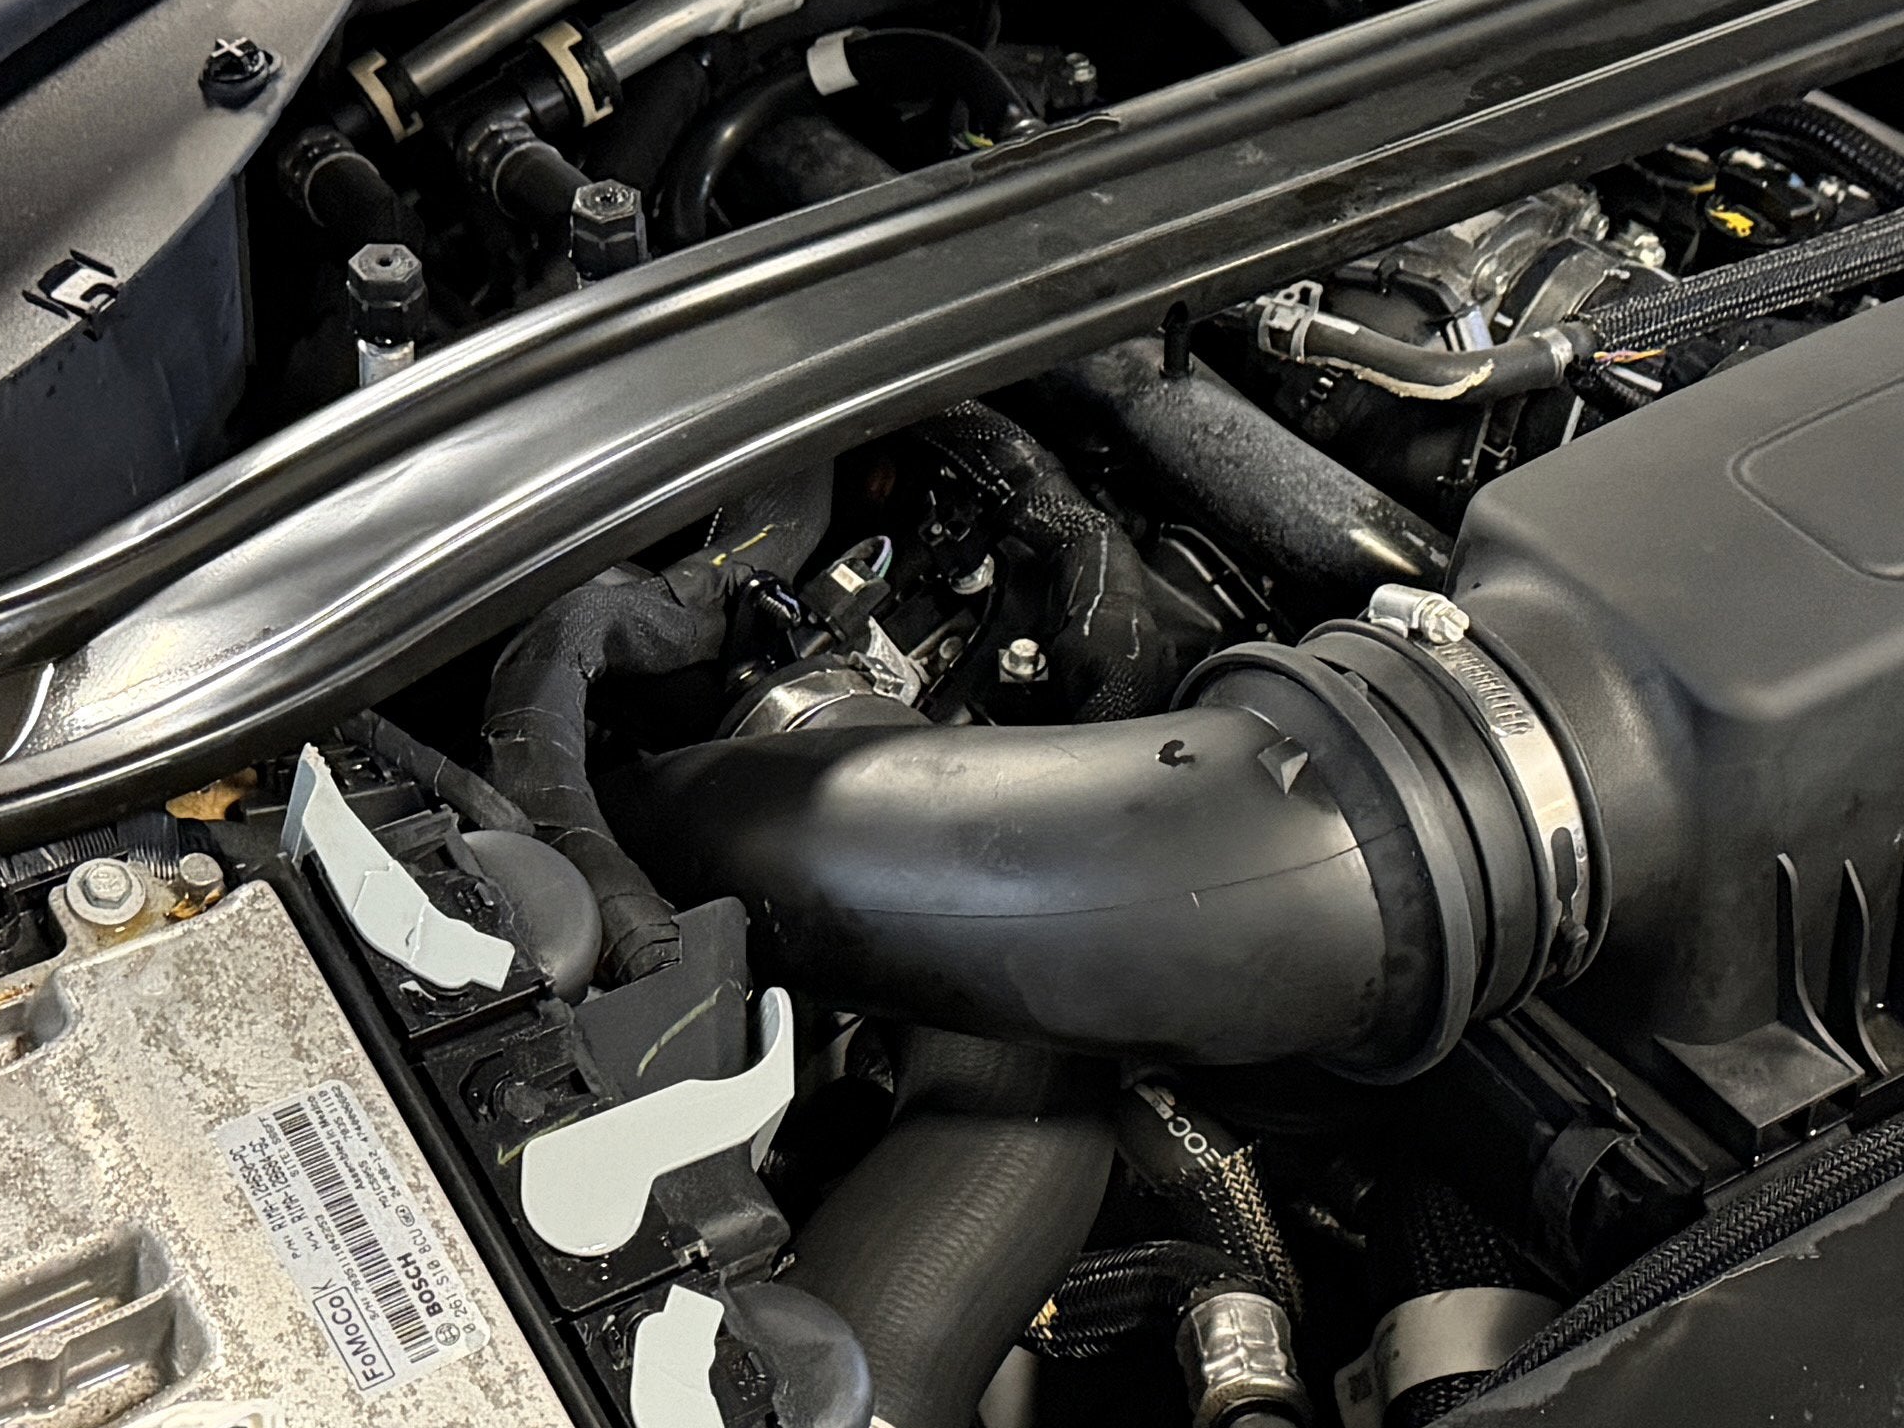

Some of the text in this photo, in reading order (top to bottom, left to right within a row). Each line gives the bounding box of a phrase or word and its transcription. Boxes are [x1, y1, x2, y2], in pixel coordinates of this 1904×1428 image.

[307, 1095, 365, 1190] Assembled in Mexico
[278, 1148, 300, 1178] SITE:
[409, 1228, 432, 1254] 8CU
[397, 1253, 443, 1317] BOSCH
[427, 1259, 449, 1286] S10
[446, 1293, 468, 1318] 261
[329, 1296, 384, 1382] FoMoCo
